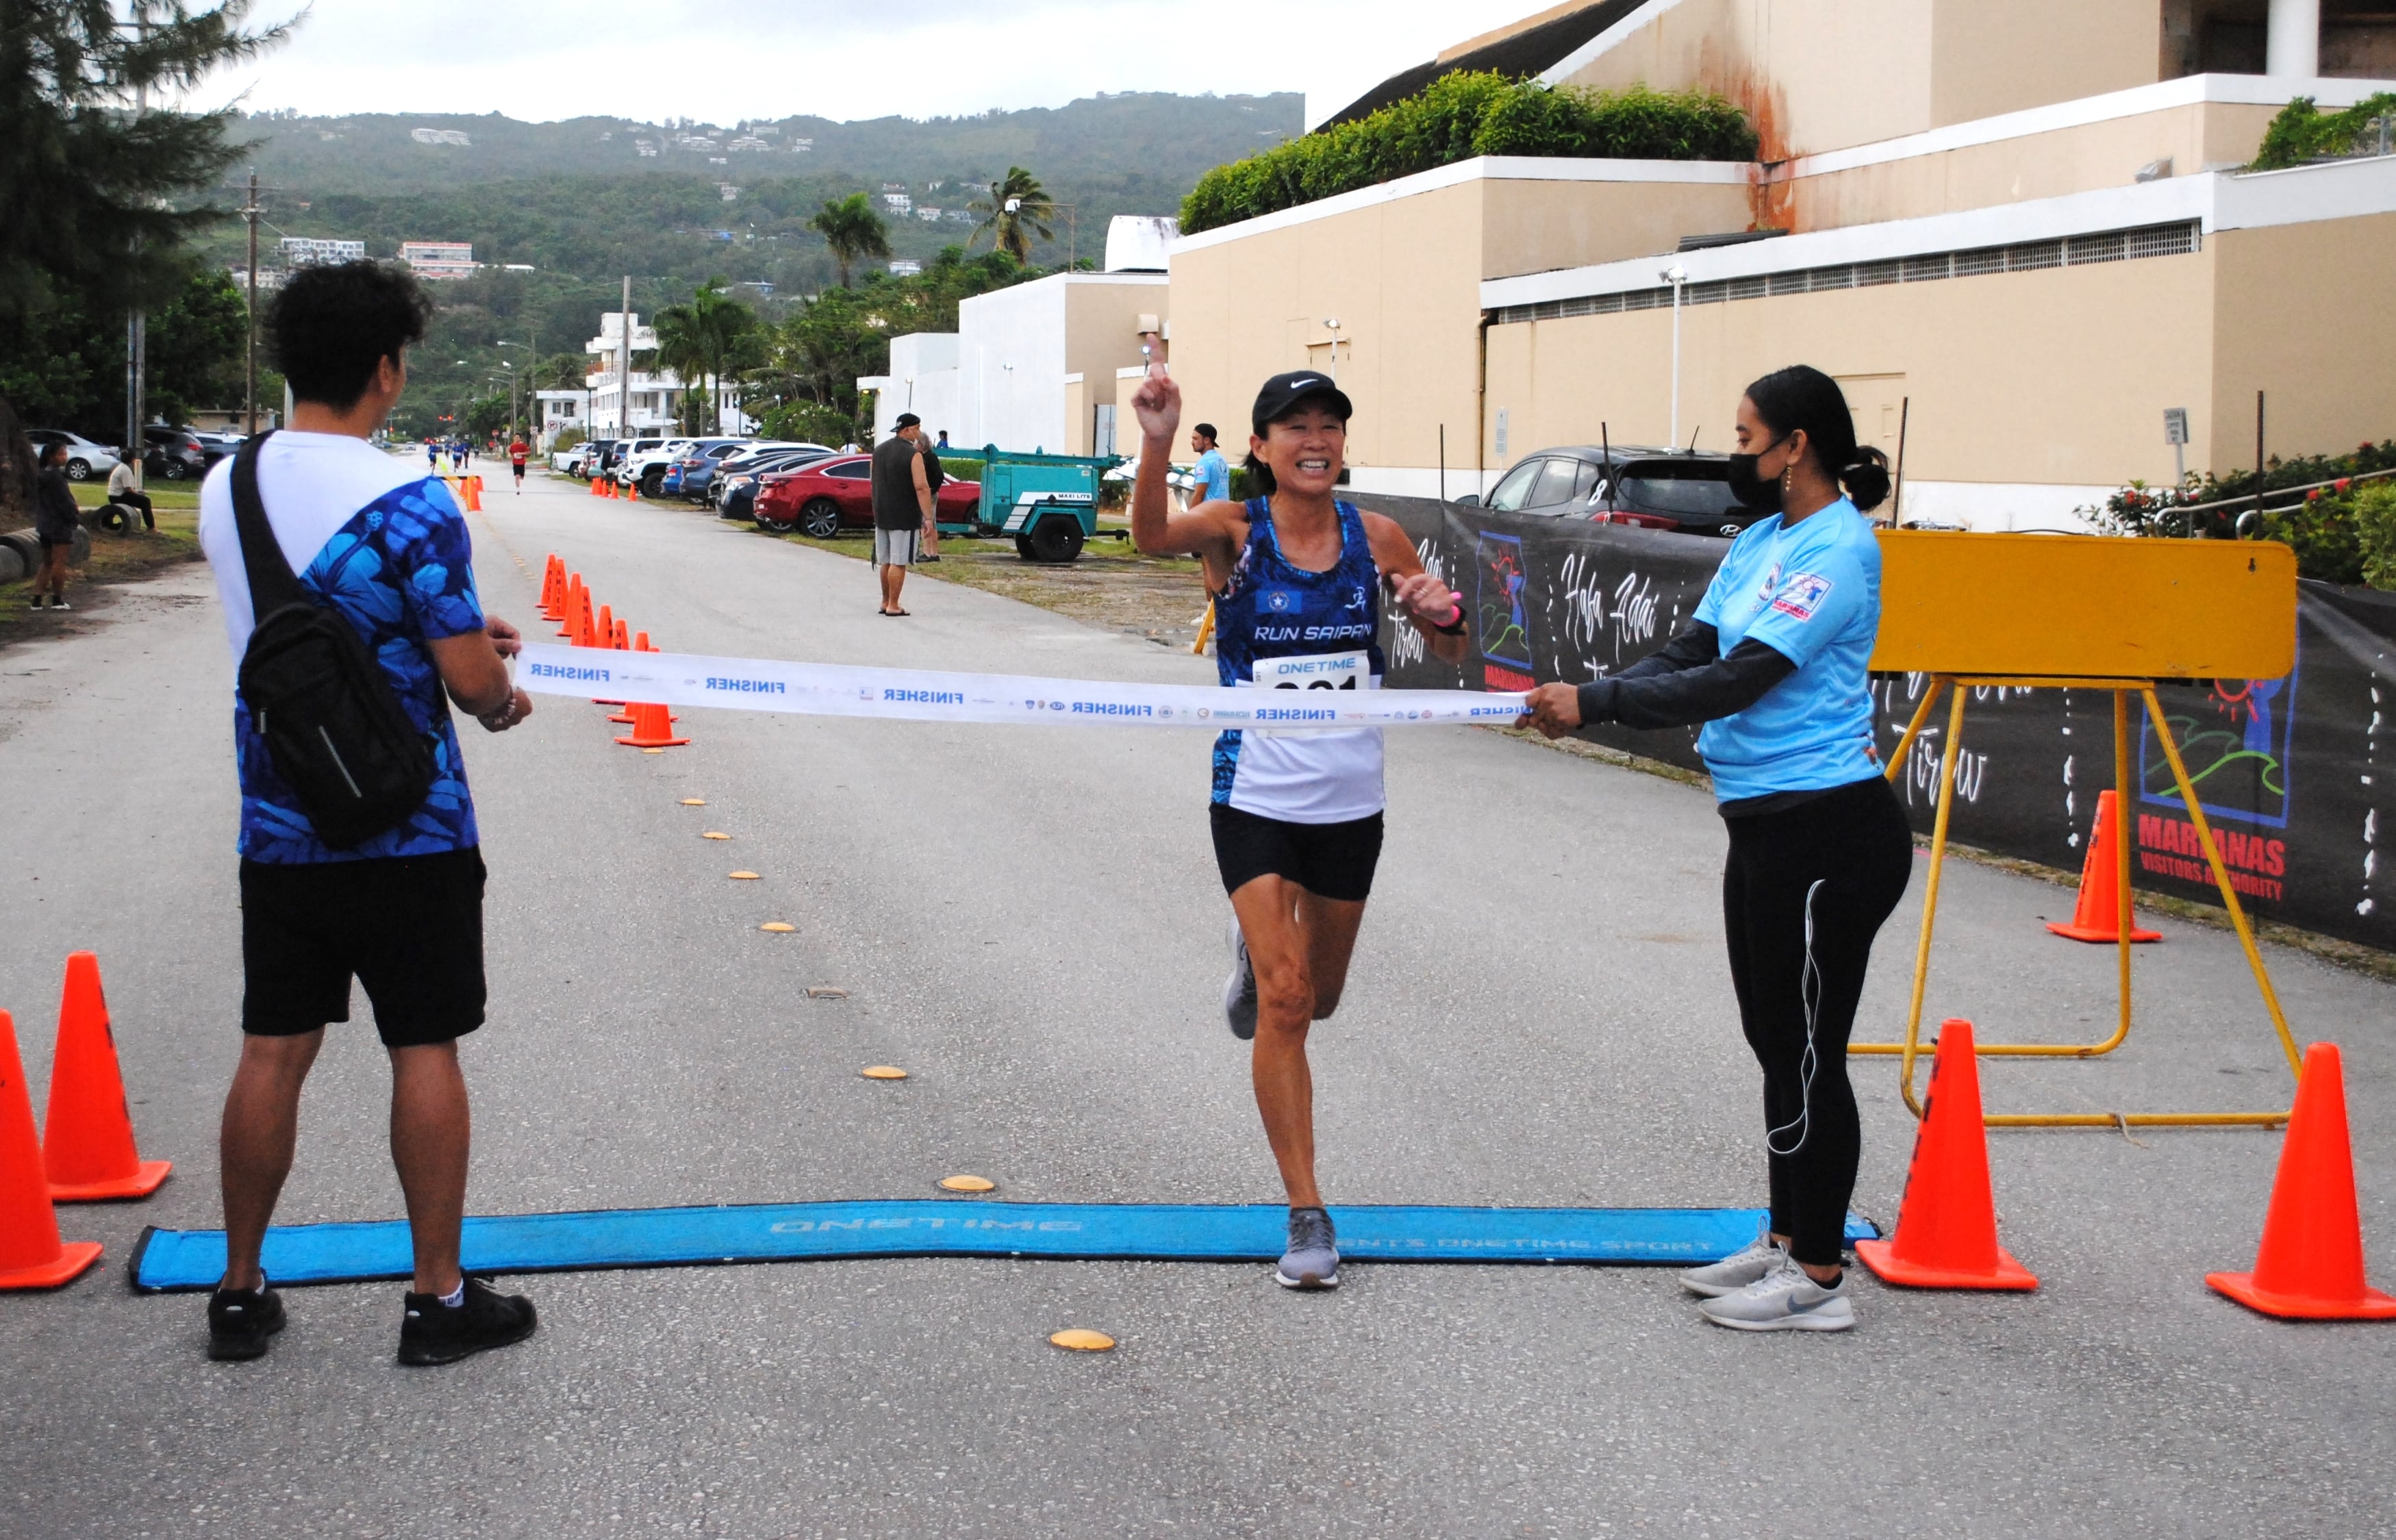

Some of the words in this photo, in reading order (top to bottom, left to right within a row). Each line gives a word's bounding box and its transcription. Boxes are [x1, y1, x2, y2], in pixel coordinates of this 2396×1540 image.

[1587, 479, 1608, 506] 8
[1254, 627, 1300, 640] RUN
[1303, 624, 1372, 640] SAIPAN
[1278, 657, 1356, 674] ONETIME
[1891, 723, 1988, 807] Tirw
[2141, 851, 2202, 882] VISITORS
[2204, 866, 2283, 902] AHORITY
[770, 1217, 1083, 1233] ONETIME
